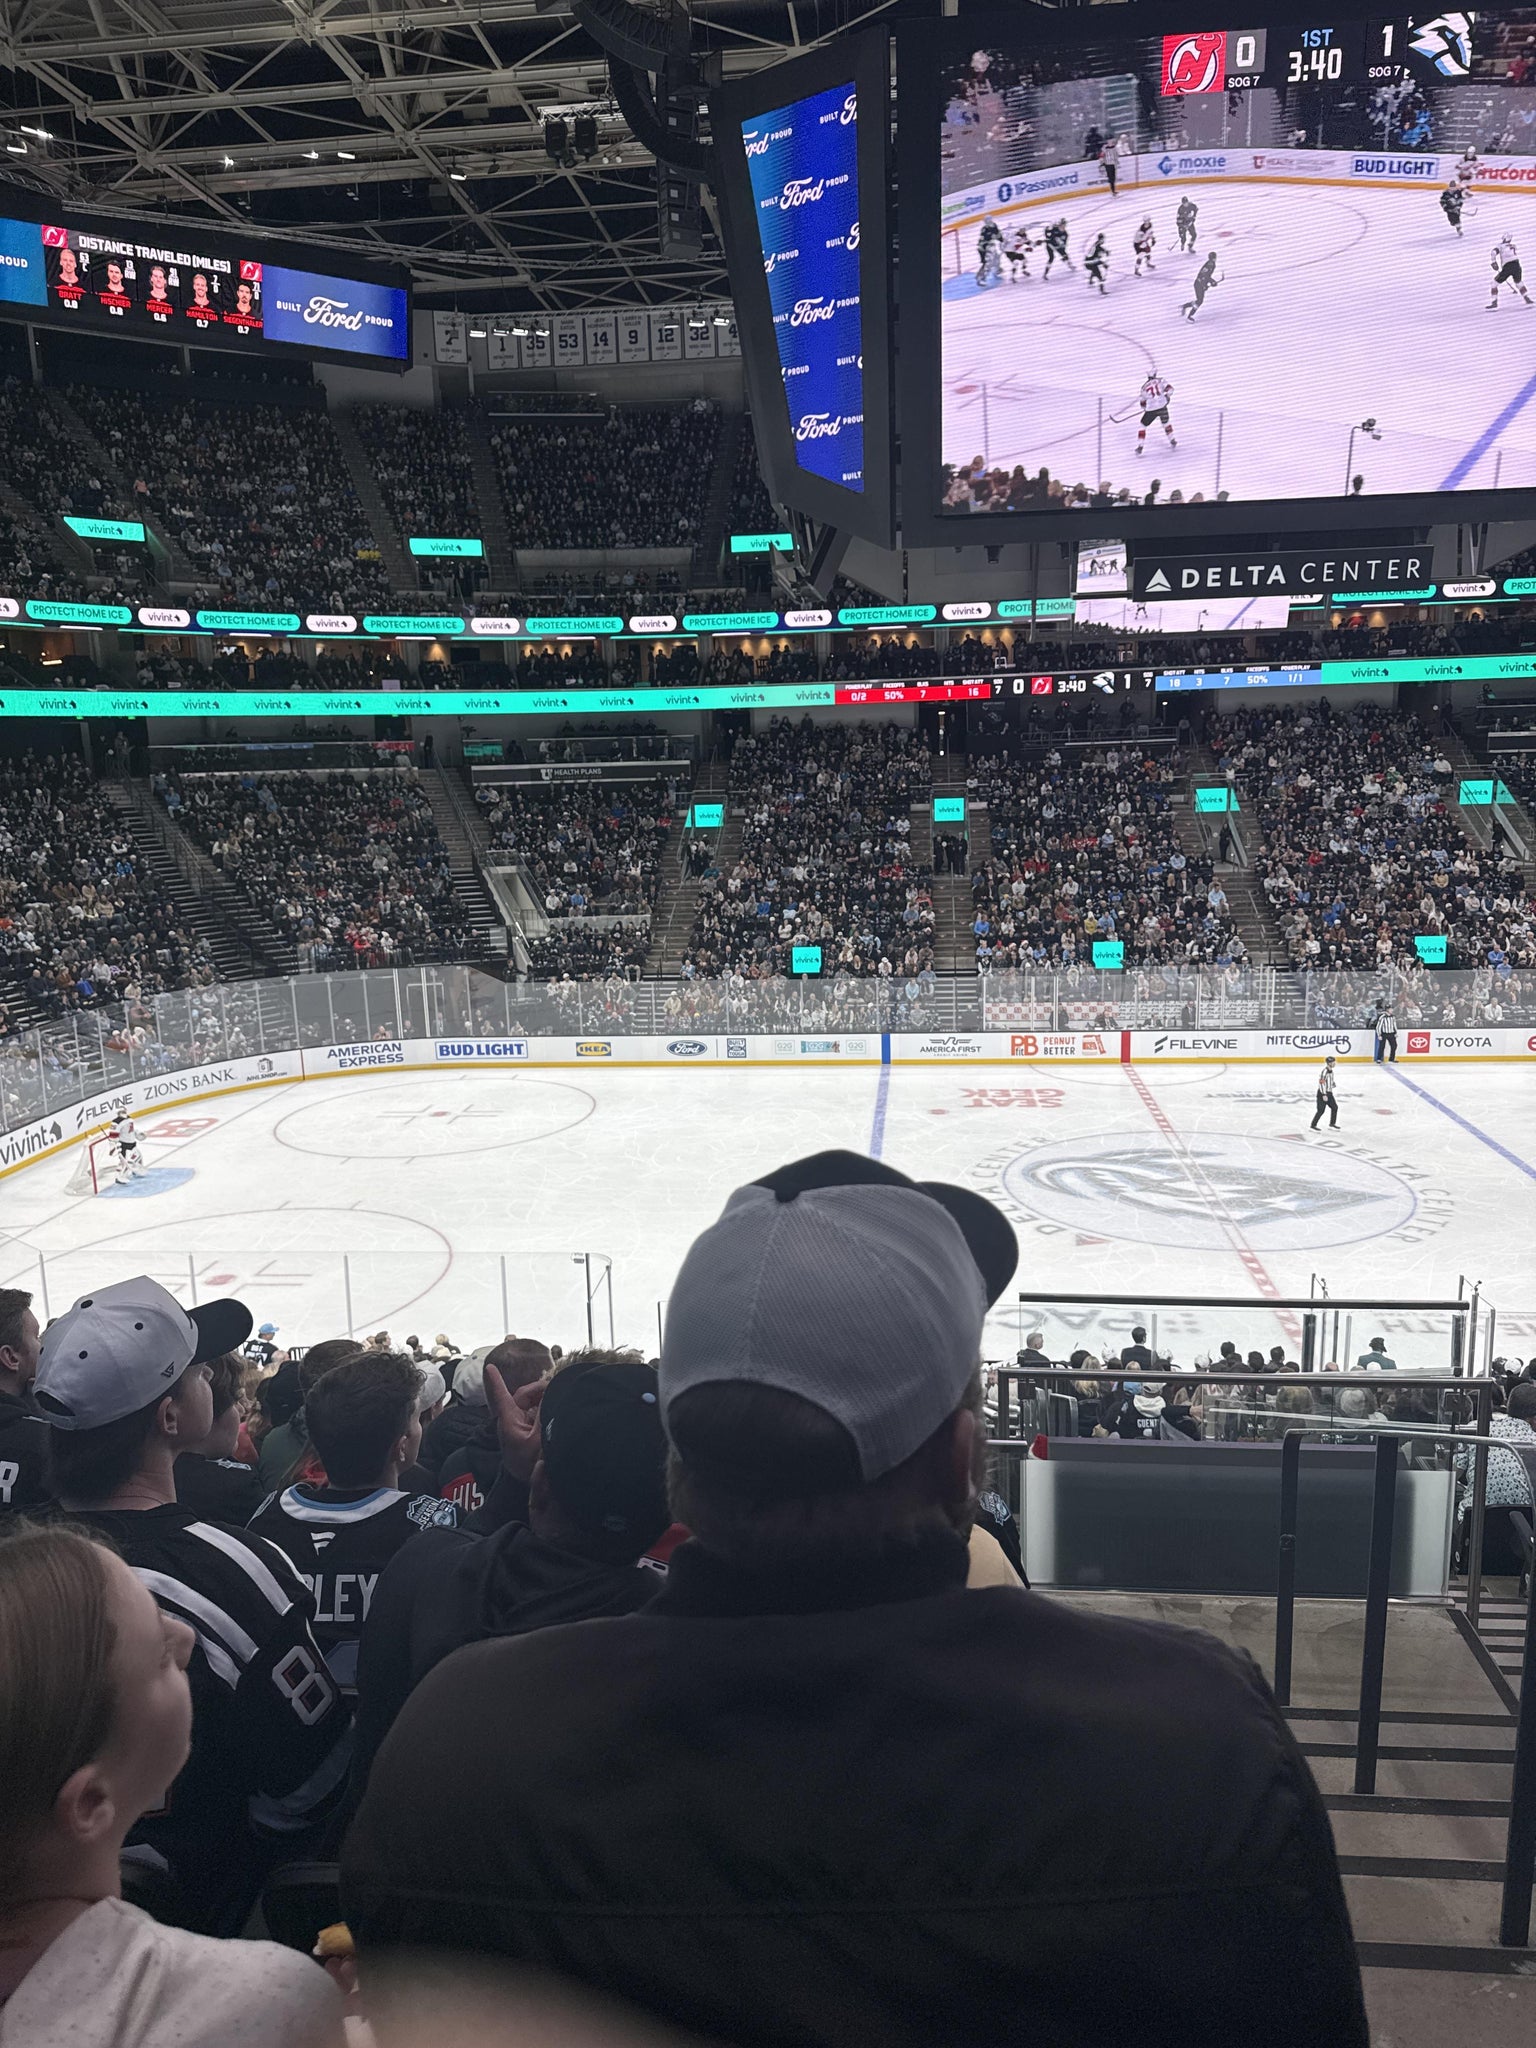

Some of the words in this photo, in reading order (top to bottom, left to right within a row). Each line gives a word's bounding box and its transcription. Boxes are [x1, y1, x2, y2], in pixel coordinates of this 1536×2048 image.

[1301, 28, 1333, 48] 1ST
[1383, 25, 1393, 57] 1
[1236, 36, 1256, 67] 0
[1287, 47, 1342, 82] 3:40
[1368, 66, 1391, 78] SOG
[1393, 65, 1400, 76] 7
[1228, 77, 1250, 88] SOG
[1253, 76, 1260, 86] 7
[819, 111, 838, 125] BUILT
[770, 128, 793, 141] PROUD
[1179, 156, 1226, 168] moxie
[1355, 159, 1384, 173] BUD
[1388, 160, 1434, 175] LIGHT
[761, 195, 778, 209] BUILT
[780, 176, 823, 210] Ford
[826, 174, 849, 188] PROUD
[826, 235, 845, 249] BUILT
[78, 235, 134, 256] DISTANCE
[134, 247, 191, 266] TRAVELED
[192, 254, 231, 273] (MILES)
[777, 249, 799, 262] PROUD
[276, 299, 301, 312] BUILT
[303, 296, 362, 331] Ford
[365, 315, 393, 327] PROUD
[790, 296, 835, 328] Ford
[837, 295, 860, 308] PROUD
[593, 331, 609, 347] 14
[628, 330, 638, 345] 9
[658, 328, 674, 343] 12
[690, 326, 709, 341] 32
[526, 336, 545, 350] 35
[559, 333, 578, 349] 53
[837, 355, 856, 367] BUILT
[787, 364, 810, 377] PROUD
[796, 411, 841, 441] Ford
[842, 471, 862, 482] BUILT
[88, 524, 115, 535] vivint
[430, 543, 455, 552] vivint
[1181, 564, 1286, 589] DELTA
[1300, 558, 1421, 583] CENTER
[1452, 584, 1478, 593] vivint
[1046, 600, 1074, 610] HOME
[33, 605, 75, 617] PROTECT
[78, 607, 106, 618] HOME
[108, 609, 124, 619] ICE
[845, 610, 884, 620] PROTECT
[886, 609, 912, 619] HOME
[914, 608, 929, 617] ICE
[951, 606, 975, 616] vivint
[148, 612, 173, 622] vivint
[203, 614, 246, 624] PROTECT
[247, 616, 275, 626] HOME
[277, 617, 292, 627] ICE
[689, 617, 727, 627] PROTECT
[729, 616, 755, 625] HOME
[757, 616, 771, 624] ICE
[794, 613, 817, 623] vivint
[315, 618, 340, 628] vivint
[370, 620, 410, 629] PROTECT
[413, 620, 440, 629] HOME
[442, 621, 457, 629] ICE
[480, 621, 504, 630] vivint
[532, 621, 572, 630] PROTECT
[574, 621, 600, 629] HOME
[602, 621, 616, 629] ICE
[638, 619, 662, 628] vivint
[1351, 667, 1381, 678] vivint
[1425, 665, 1455, 675] vivint
[1499, 663, 1530, 673] vivint
[1124, 673, 1131, 689] 1
[1145, 679, 1151, 687] 7
[1224, 676, 1230, 685] 7
[1247, 675, 1268, 684] 50%
[1288, 673, 1303, 682] 1/1
[995, 685, 1001, 694] 7
[1012, 678, 1024, 694] 0
[1057, 680, 1087, 693] 3:40
[731, 693, 756, 703] vivint
[796, 691, 822, 701] vivint
[851, 692, 867, 701] 0/2
[884, 690, 904, 700] 50%
[920, 689, 926, 698] 7
[947, 688, 952, 697] 1
[968, 688, 979, 697] 16
[39, 699, 67, 710] vivint
[111, 699, 139, 710] vivint
[183, 699, 211, 710] vivint
[254, 699, 282, 710] vivint
[395, 699, 422, 709] vivint
[465, 698, 491, 709] vivint
[533, 698, 560, 708] vivint
[600, 696, 626, 706] vivint
[666, 695, 691, 705] vivint
[1043, 1037, 1076, 1045] PEANUT
[1170, 1039, 1238, 1049] FILEVINE
[1436, 1037, 1492, 1048] TOYOTA
[327, 1042, 402, 1059] AMERICAN
[439, 1044, 474, 1056] BUD
[477, 1043, 524, 1056] LIGHT
[579, 1045, 608, 1055] IKEA
[674, 1041, 701, 1055] Ford
[1043, 1047, 1076, 1055] BETTER
[338, 1053, 404, 1068] EXPRESS
[144, 1079, 188, 1100] ZIONS
[192, 1068, 235, 1088] BANK
[958, 1088, 1066, 1098] GEEK
[86, 1093, 134, 1121] FILEVINE
[963, 1098, 1064, 1108] SEAT
[0, 1126, 49, 1165] vivint
[971, 1136, 1055, 1178] CENTER
[1314, 1140, 1430, 1181] DELTA
[1385, 1188, 1455, 1243] CENTER
[418, 1500, 440, 1525] SEASON
[271, 1645, 338, 1725] 8
